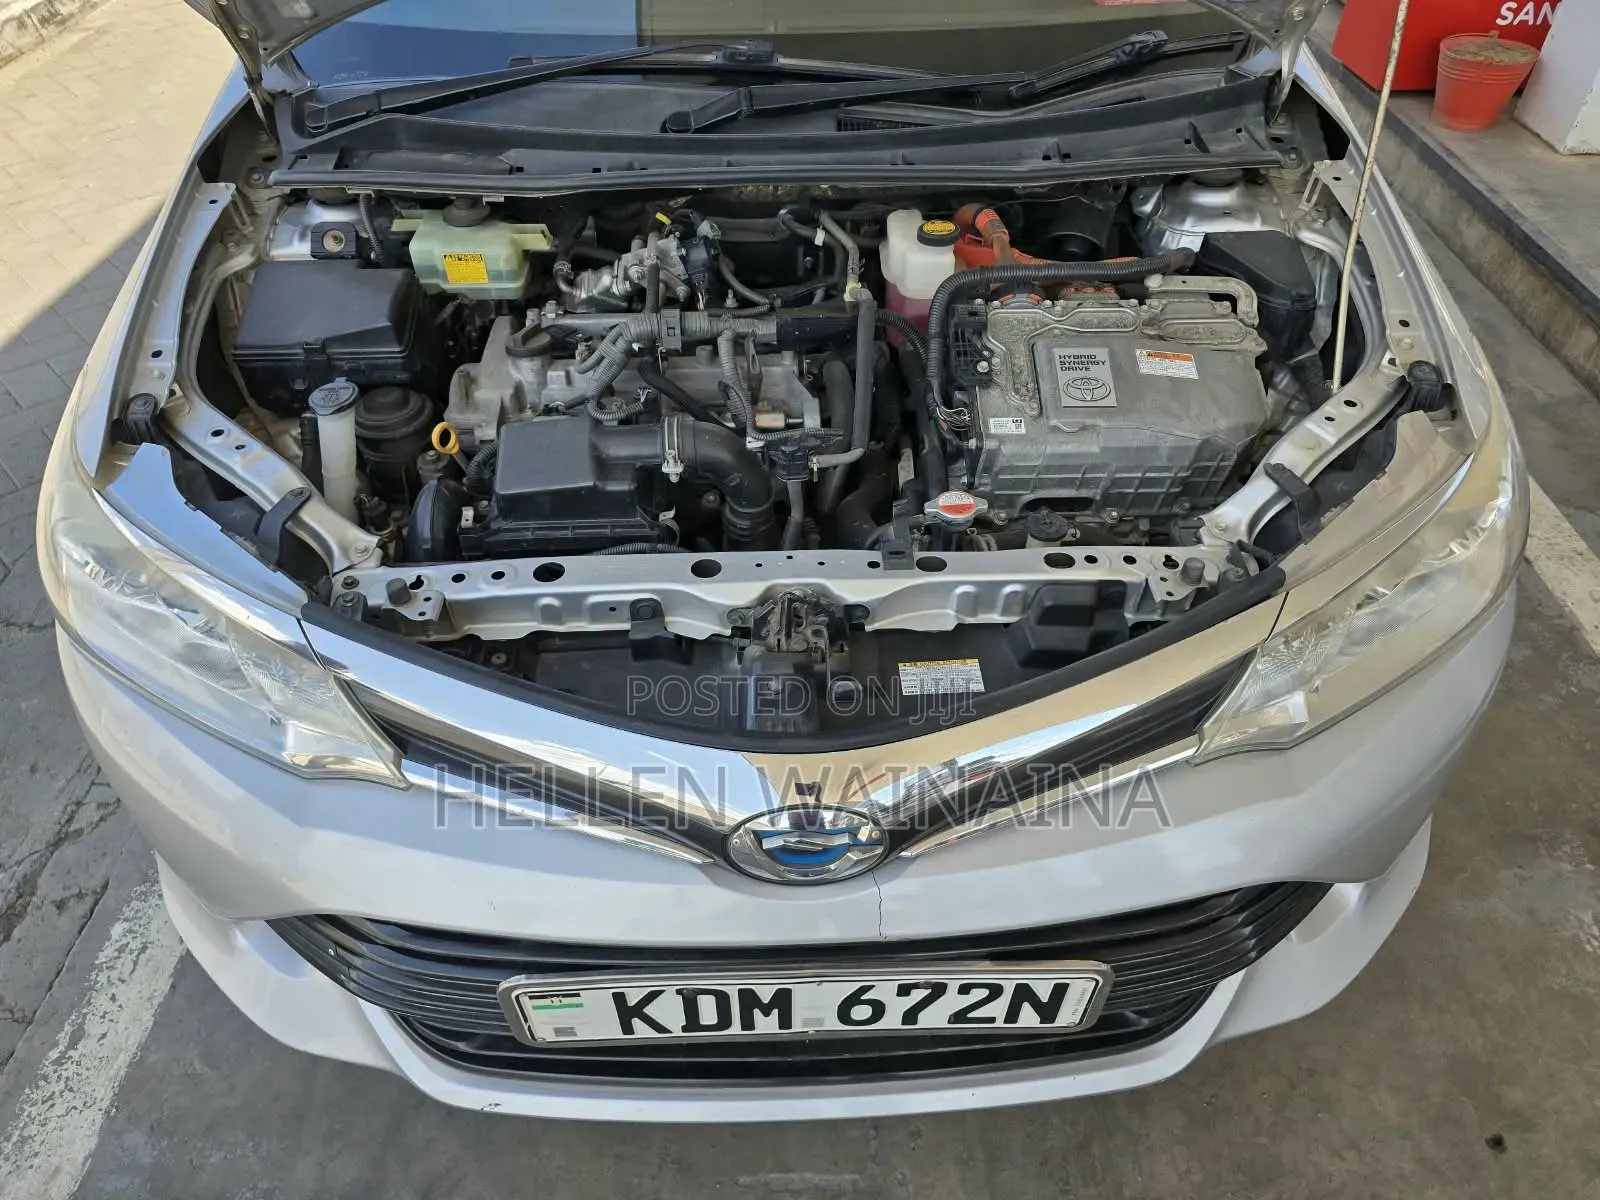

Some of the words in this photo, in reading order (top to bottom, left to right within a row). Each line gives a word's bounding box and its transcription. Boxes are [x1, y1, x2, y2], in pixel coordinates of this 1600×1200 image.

[1495, 1, 1559, 26] SAN
[611, 986, 793, 1036] KDM
[836, 981, 1070, 1026] 672N
